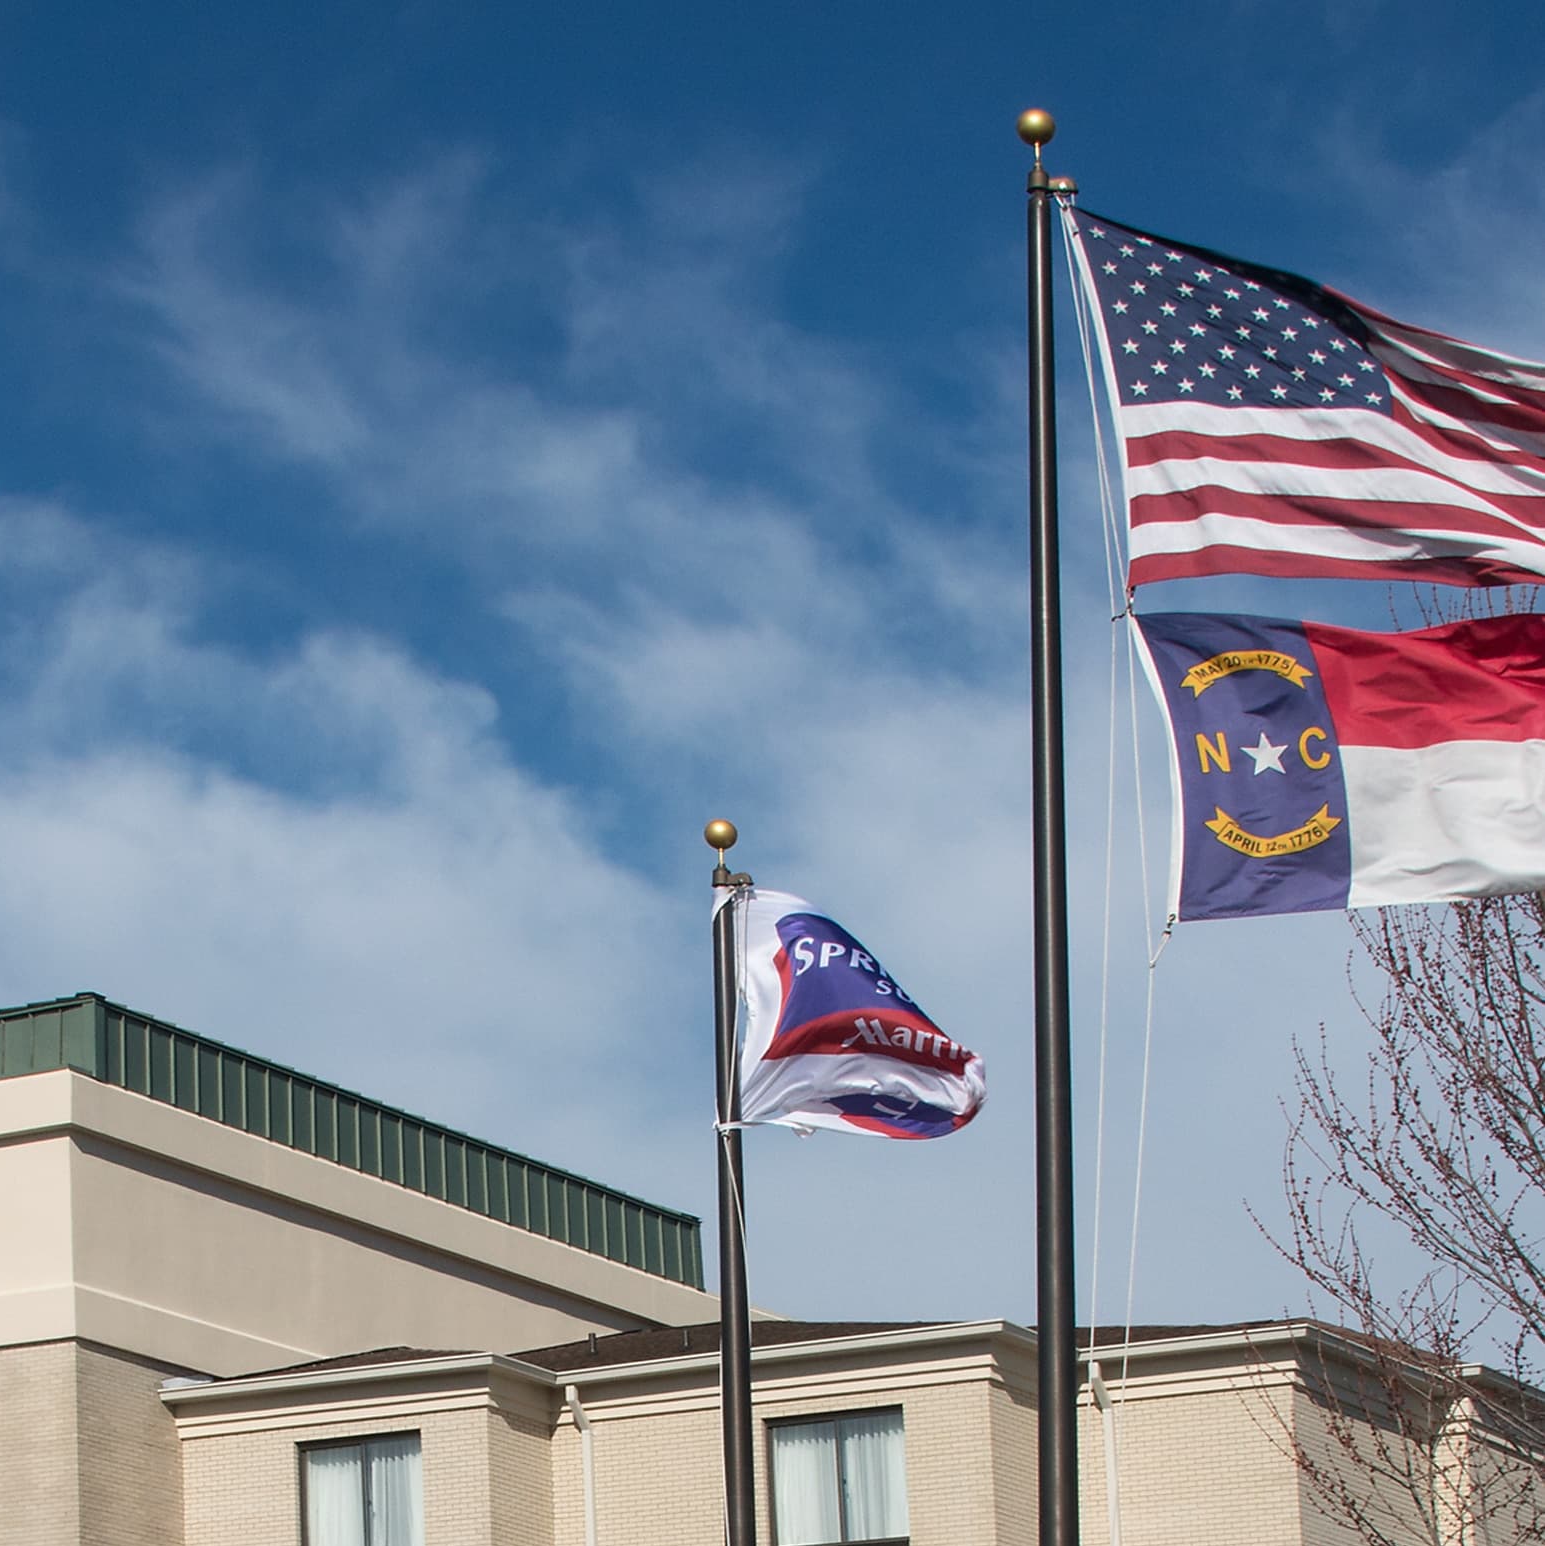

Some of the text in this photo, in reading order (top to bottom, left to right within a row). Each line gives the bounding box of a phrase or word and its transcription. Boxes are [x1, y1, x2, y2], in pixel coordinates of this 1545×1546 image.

[1194, 661, 1223, 679] MAY
[1256, 654, 1290, 670] 1775
[1196, 727, 1331, 773] N C
[1224, 830, 1262, 853] APRIL
[1289, 826, 1323, 847] 1776
